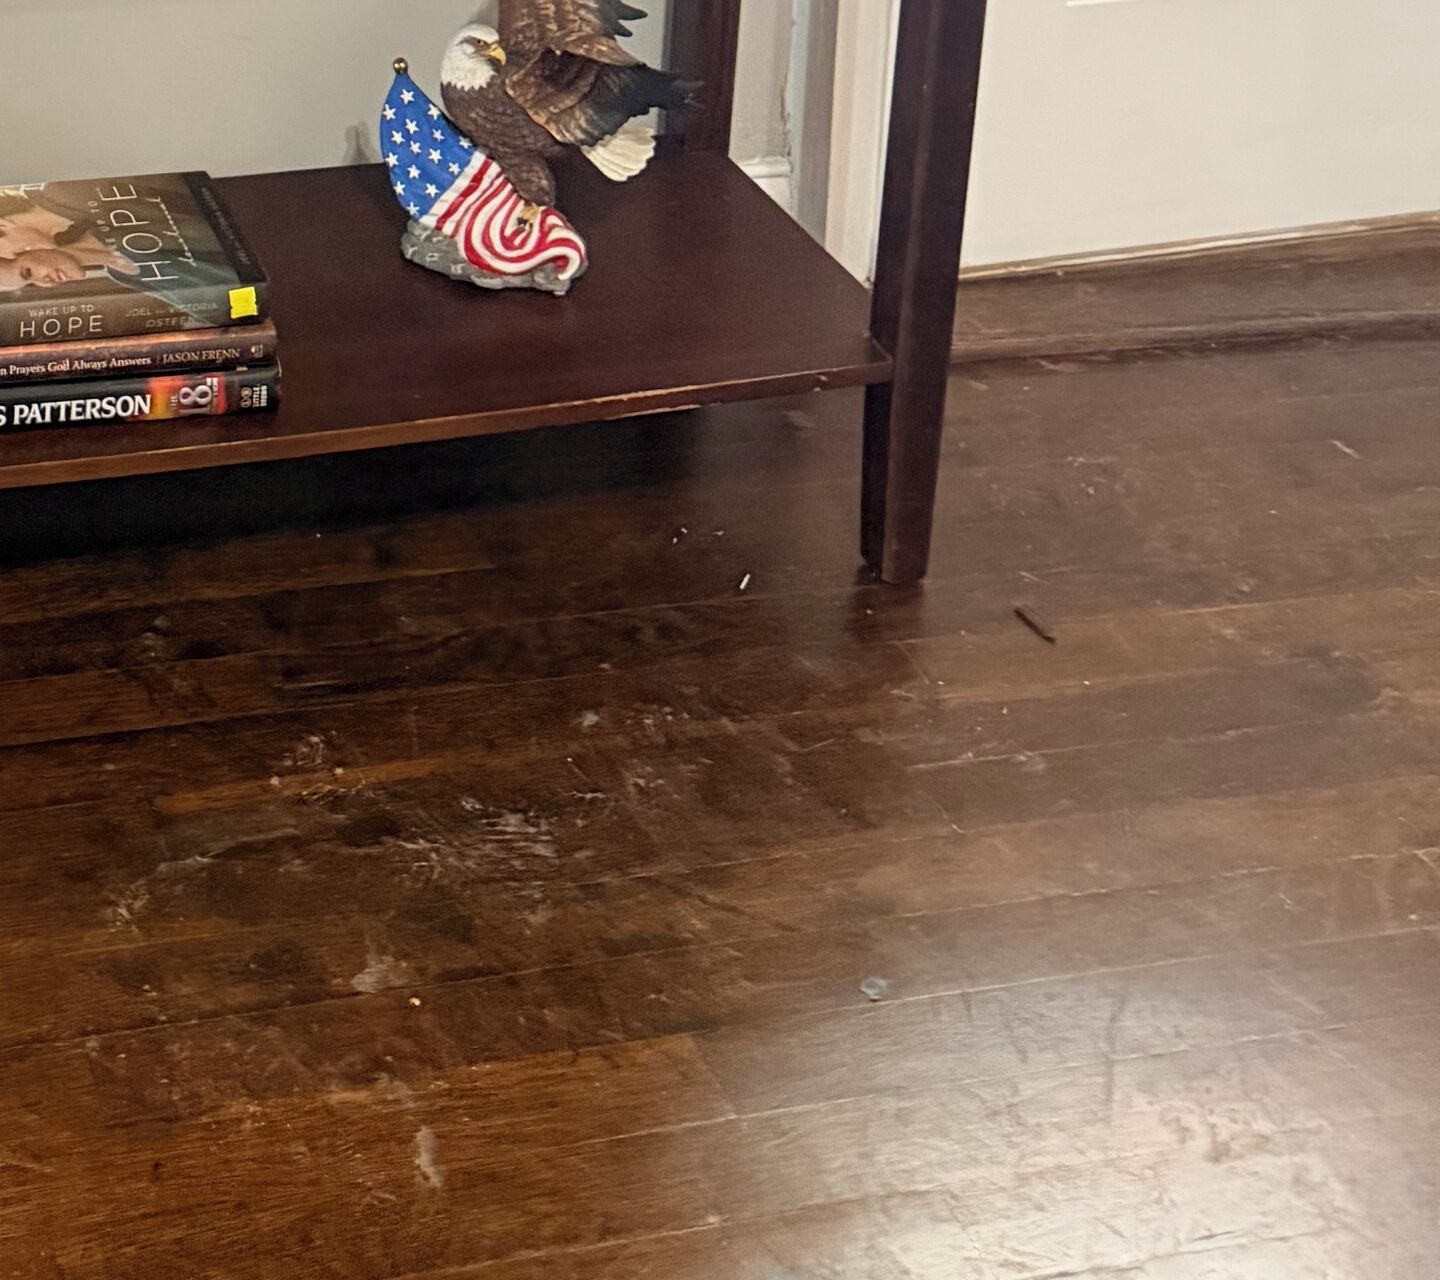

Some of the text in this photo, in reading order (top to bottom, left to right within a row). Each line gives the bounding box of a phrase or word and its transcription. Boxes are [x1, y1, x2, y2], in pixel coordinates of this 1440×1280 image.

[97, 184, 179, 281] HOPE
[28, 303, 95, 318] WAKE UP TO
[19, 314, 104, 338] HOPE
[9, 363, 47, 376] Prayers
[47, 358, 70, 372] God
[72, 359, 107, 371] Always
[109, 355, 152, 368] Answers
[162, 351, 200, 364] JASON
[13, 394, 152, 426] PATTERSON
